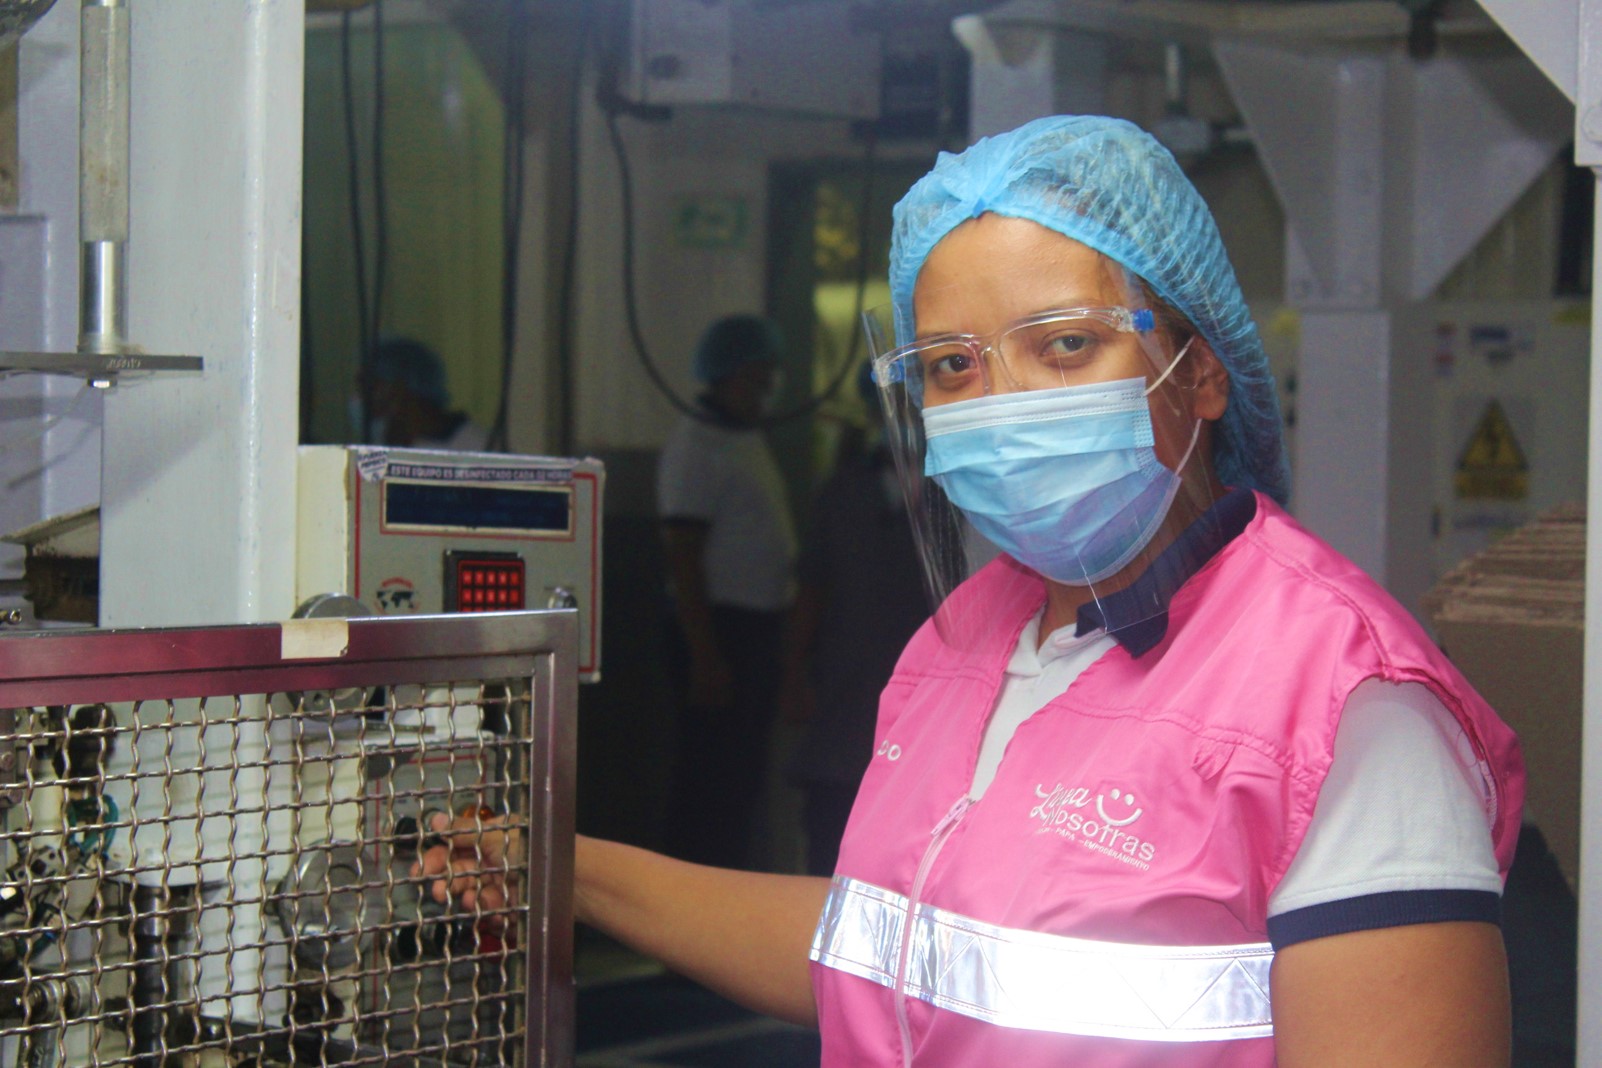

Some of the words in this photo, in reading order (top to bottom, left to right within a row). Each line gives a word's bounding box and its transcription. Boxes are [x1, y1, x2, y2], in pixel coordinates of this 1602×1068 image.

[391, 465, 410, 477] ESTE
[412, 466, 441, 479] EQUIPO
[443, 467, 453, 479] ES
